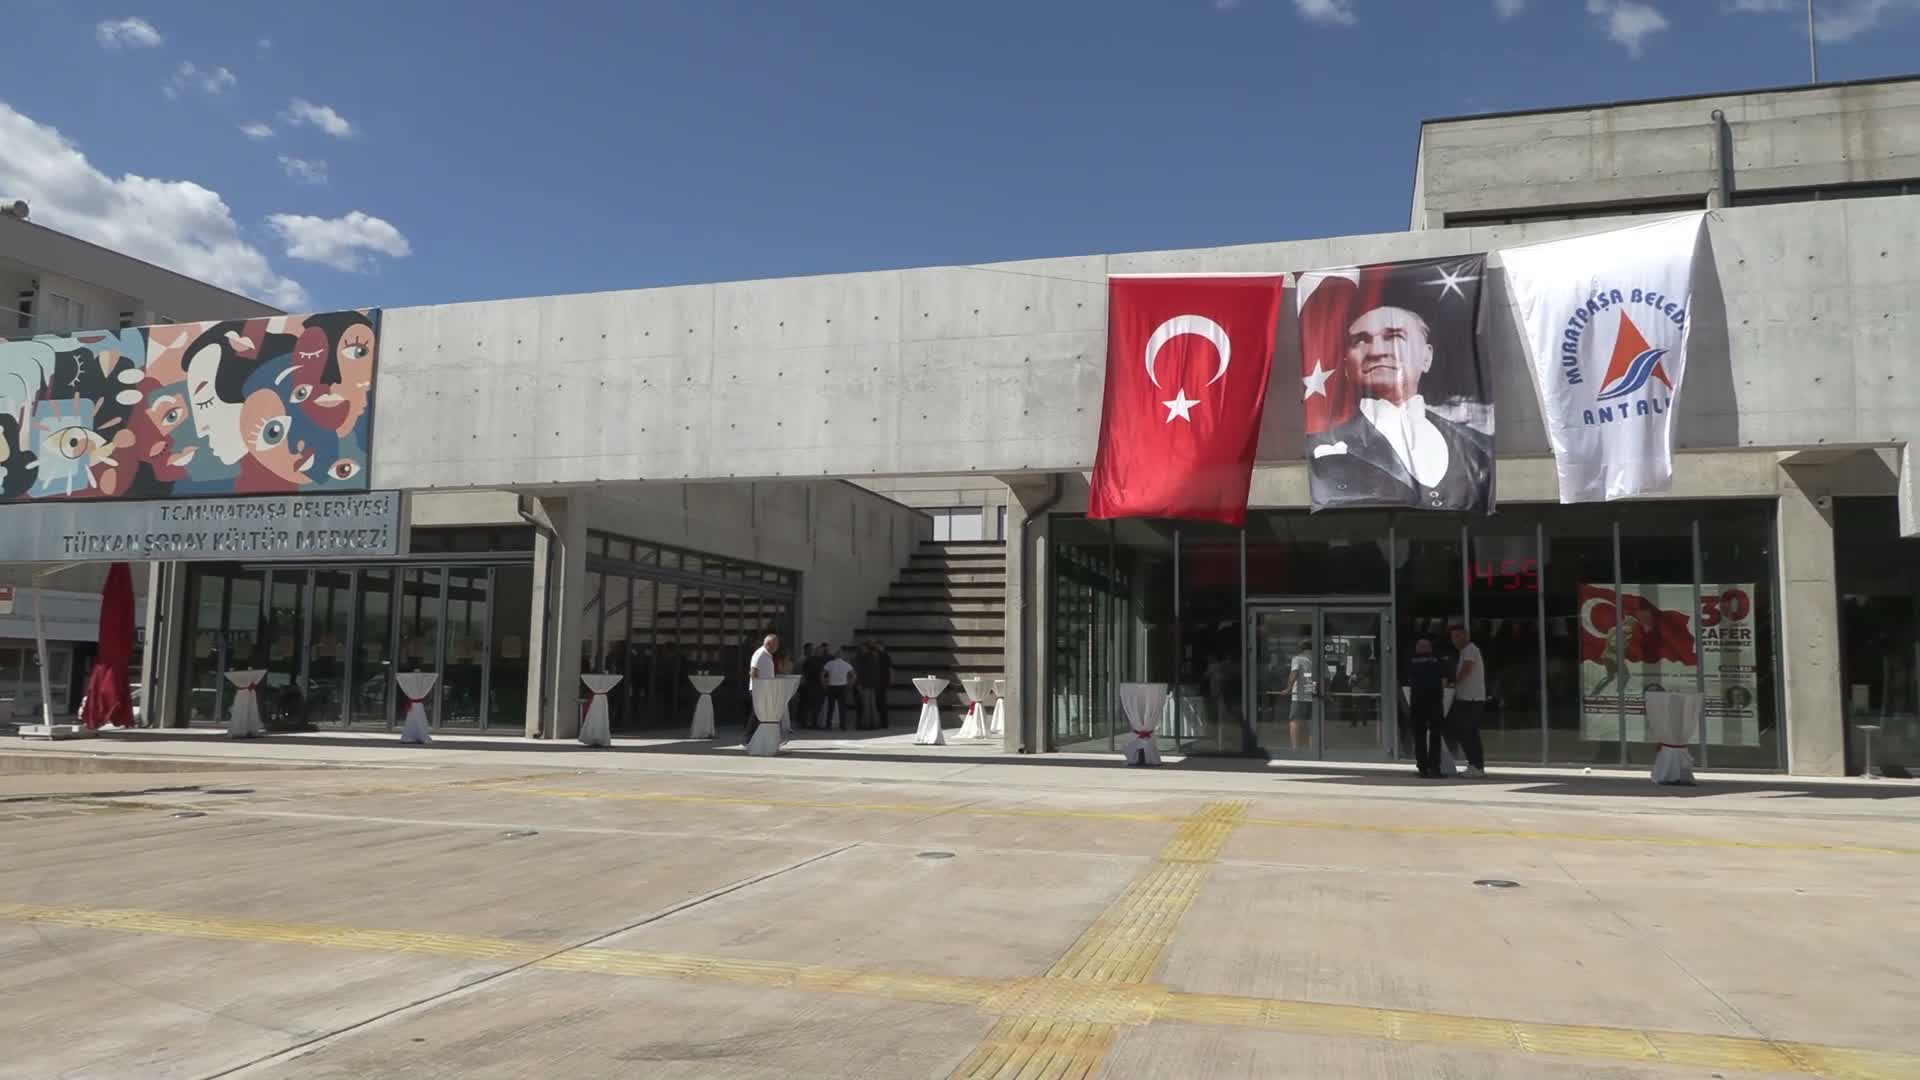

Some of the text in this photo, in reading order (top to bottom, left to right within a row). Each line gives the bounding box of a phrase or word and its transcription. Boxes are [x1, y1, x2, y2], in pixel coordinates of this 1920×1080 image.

[1562, 288, 1686, 385] MURATPAŞA BELED
[293, 496, 389, 518] BELEDİYESİ
[64, 524, 388, 556] TÜRKAN ŞORAY KÜLTÜR MERKEZİ
[1700, 589, 1750, 627] 30
